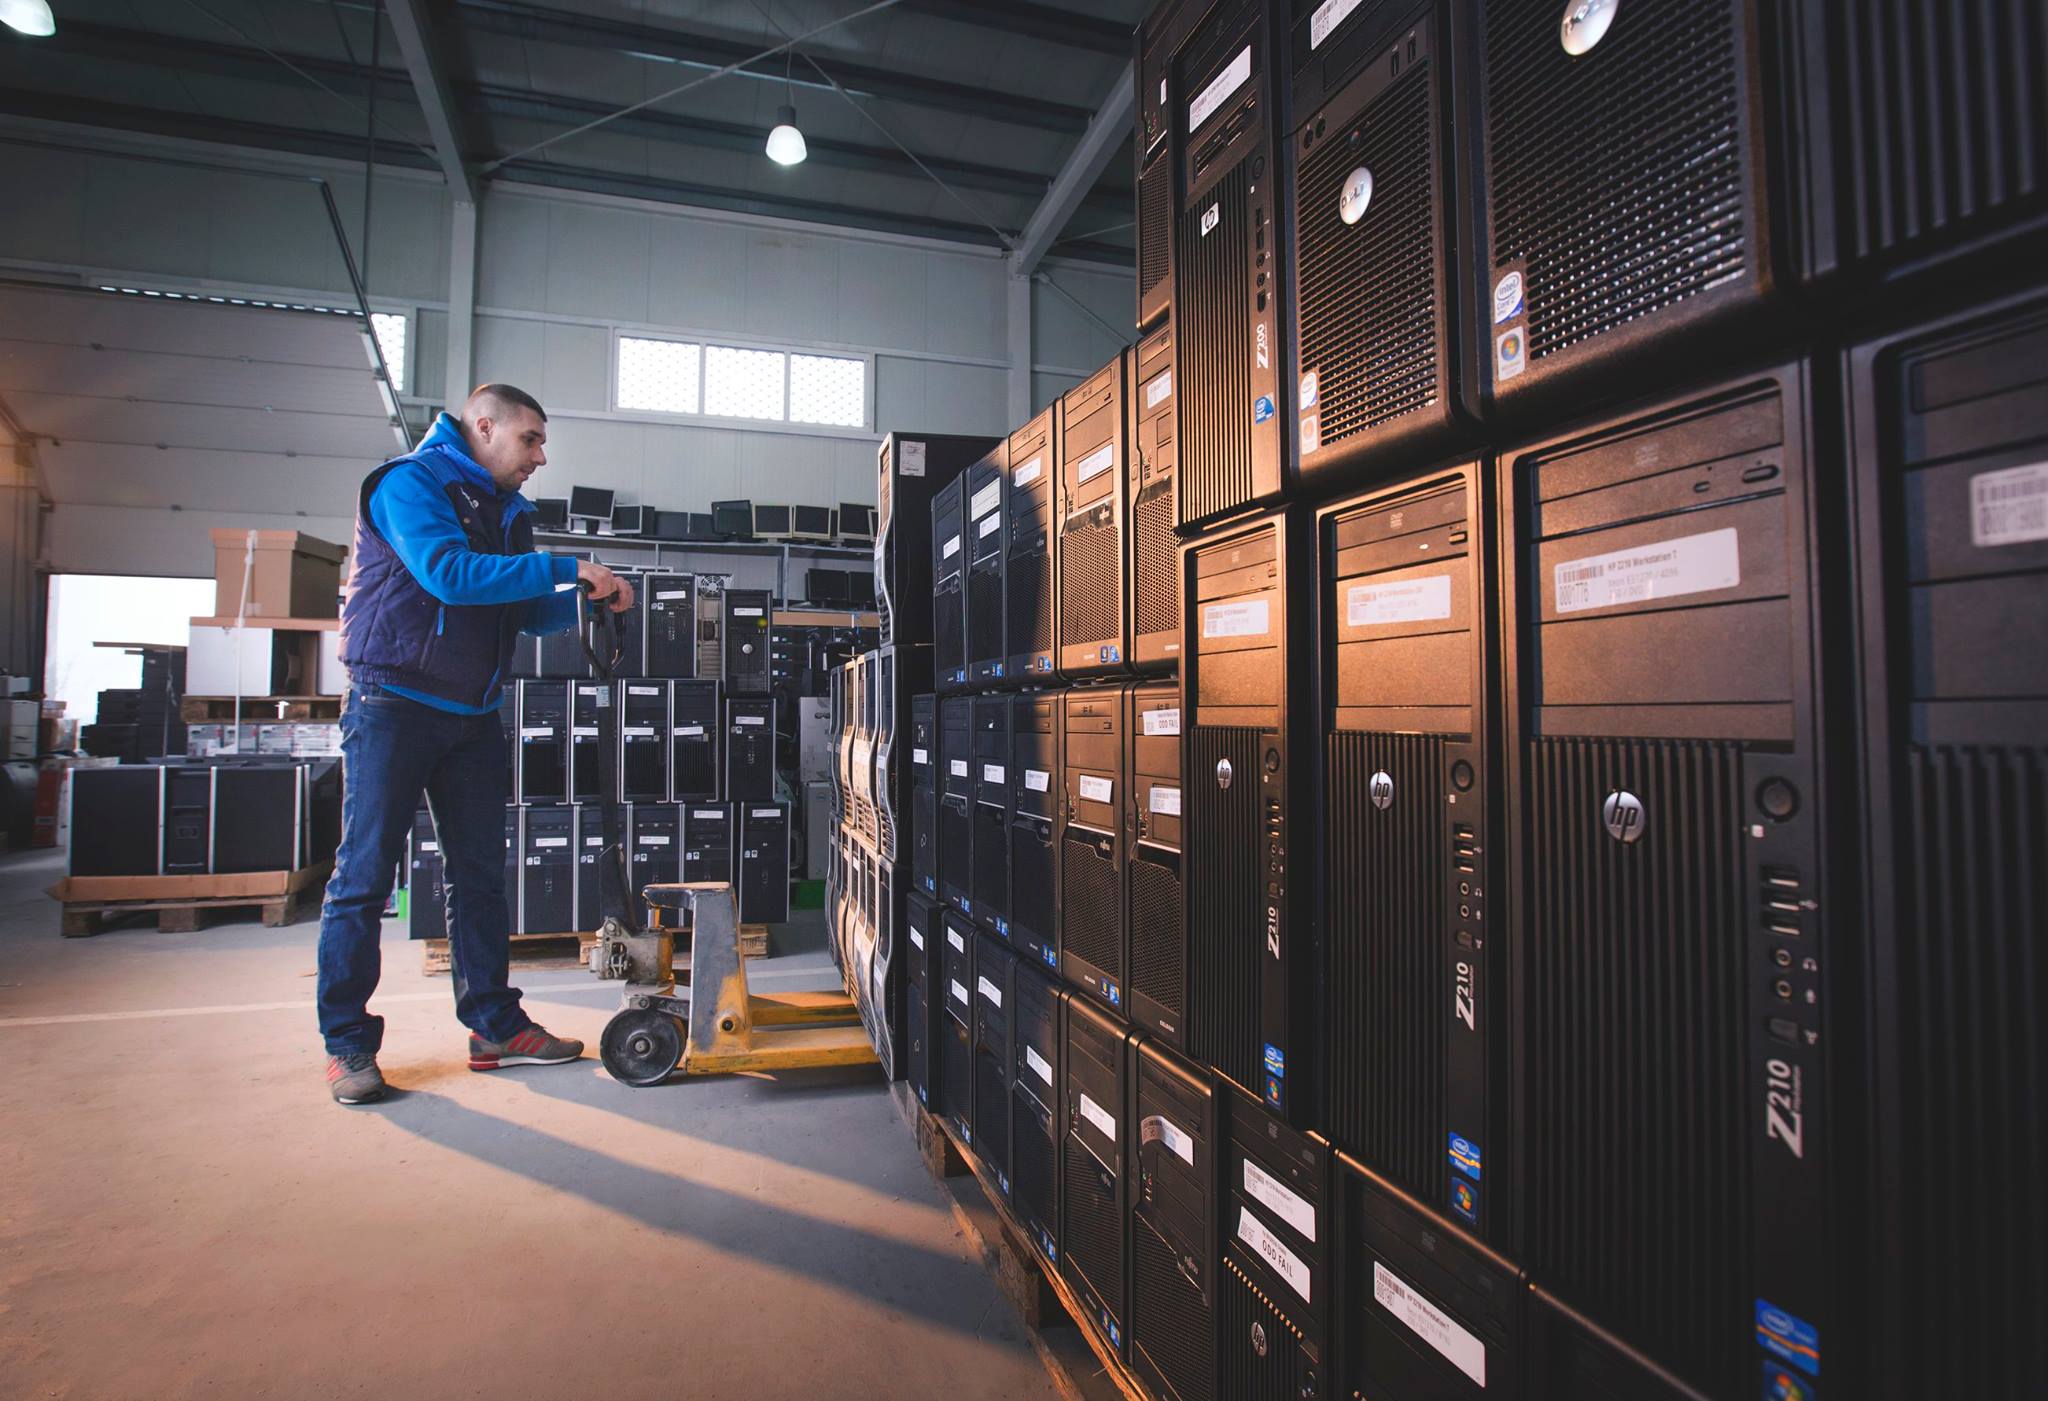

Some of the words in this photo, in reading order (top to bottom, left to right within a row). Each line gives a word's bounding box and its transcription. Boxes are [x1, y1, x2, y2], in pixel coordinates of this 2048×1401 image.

[1256, 323, 1269, 369] Z200
[1372, 771, 1391, 809] hp
[1609, 791, 1640, 841] hp
[1267, 906, 1280, 960] Z210
[1456, 961, 1475, 1031] Z210
[1766, 1058, 1803, 1159] Z210
[1261, 1239, 1277, 1261] ODD
[1278, 1254, 1294, 1278] FAIL
